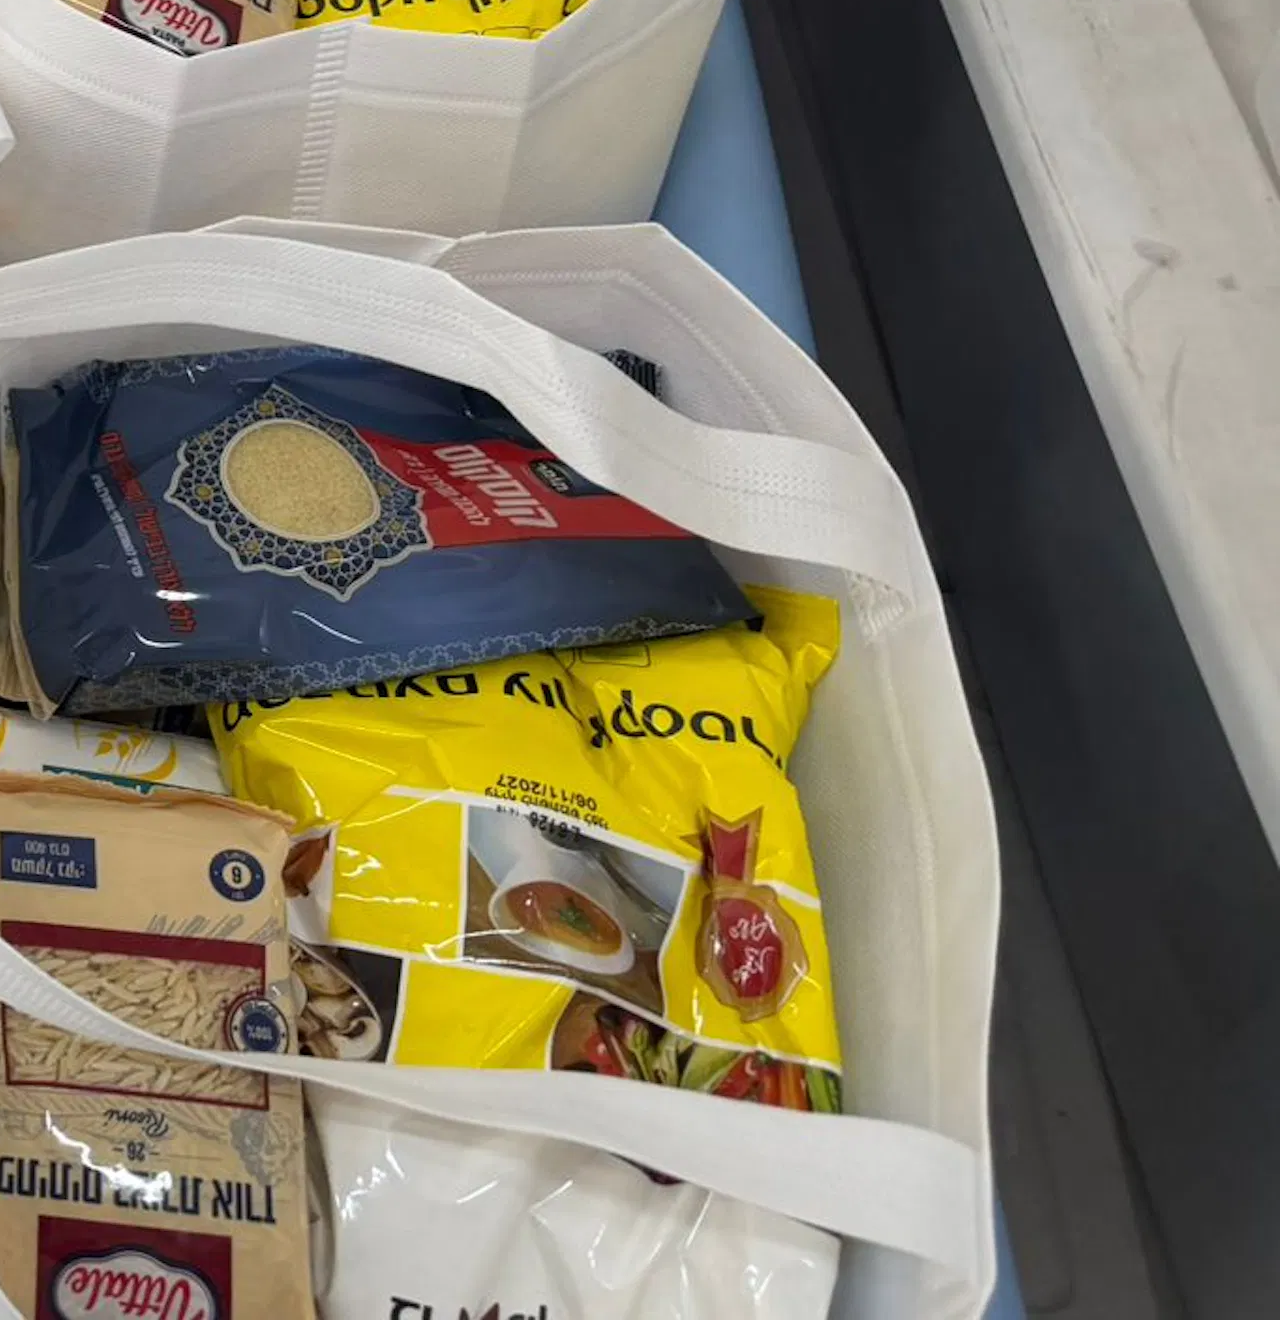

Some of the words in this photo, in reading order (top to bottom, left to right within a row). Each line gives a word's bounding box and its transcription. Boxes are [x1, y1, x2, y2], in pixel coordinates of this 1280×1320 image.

[432, 444, 559, 529] קוסקוס
[496, 773, 598, 812] 06/11/2027
[101, 1108, 170, 1140] Risoni
[211, 1179, 278, 1226] אורז
